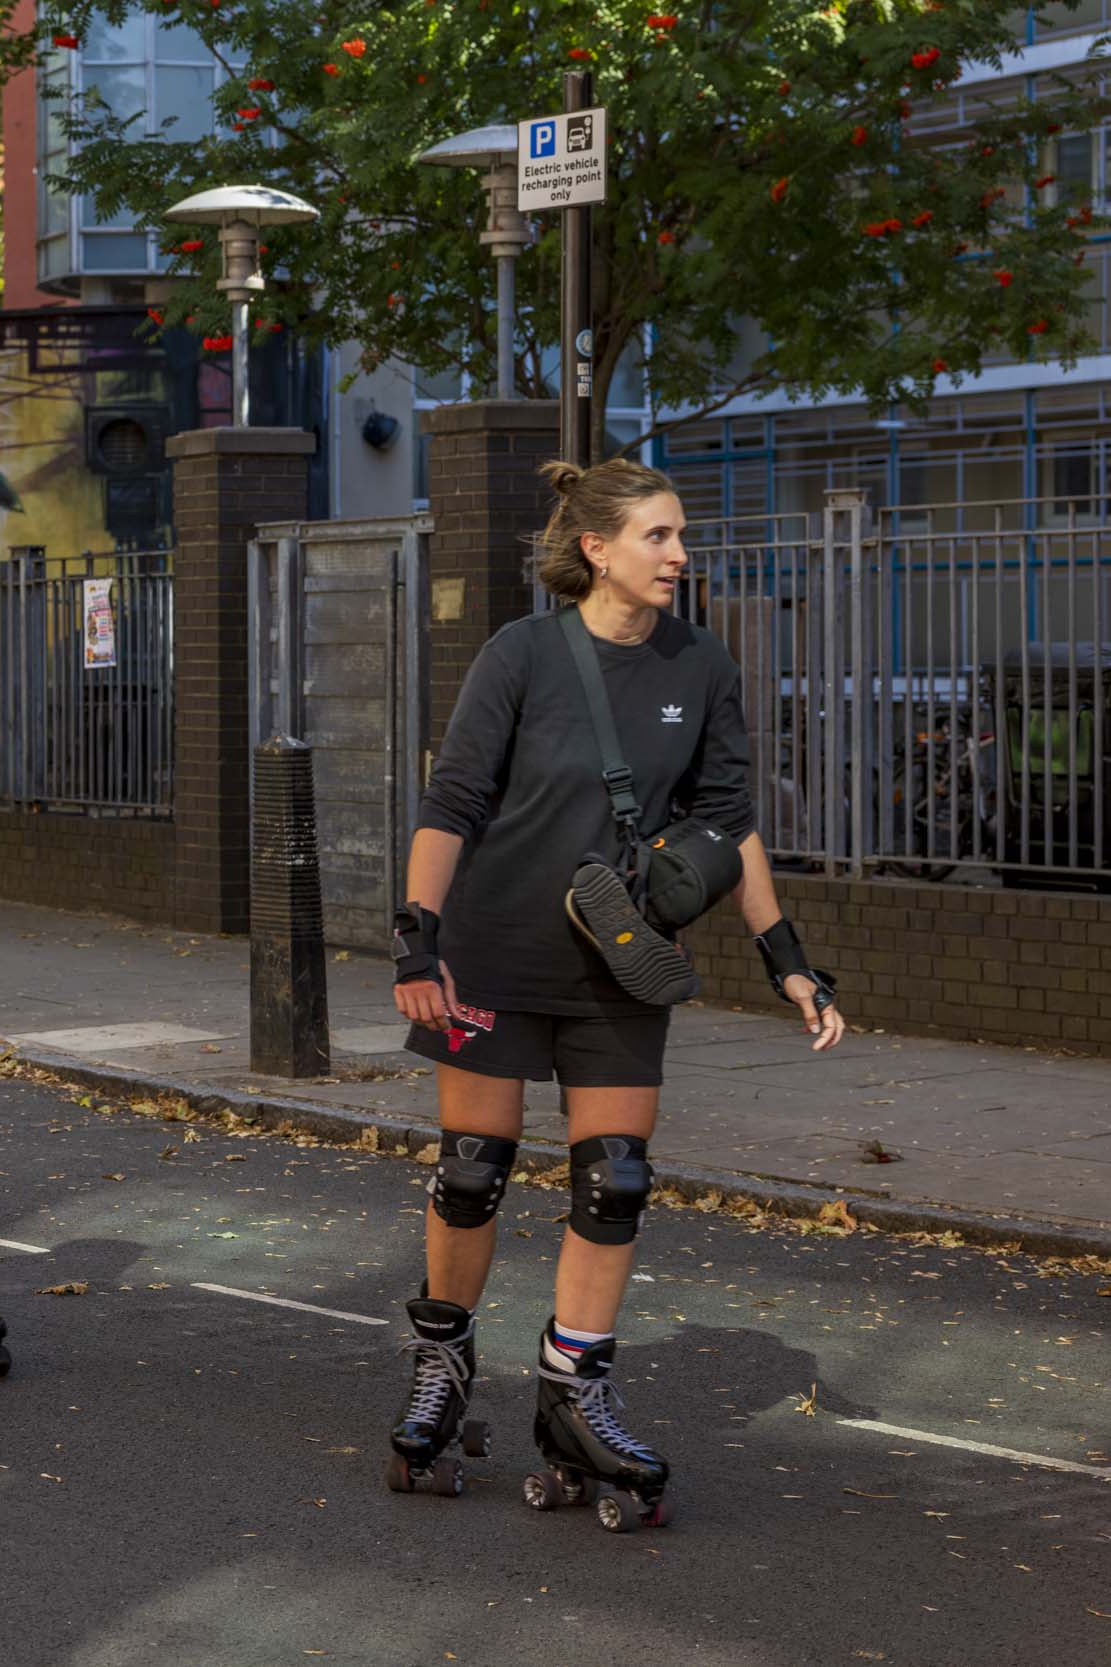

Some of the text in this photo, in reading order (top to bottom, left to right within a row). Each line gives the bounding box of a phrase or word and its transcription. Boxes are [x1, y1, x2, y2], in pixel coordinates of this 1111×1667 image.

[536, 125, 552, 155] P
[525, 157, 599, 177] Electric vehicle
[522, 170, 601, 191] recharging point
[550, 189, 571, 200] only
